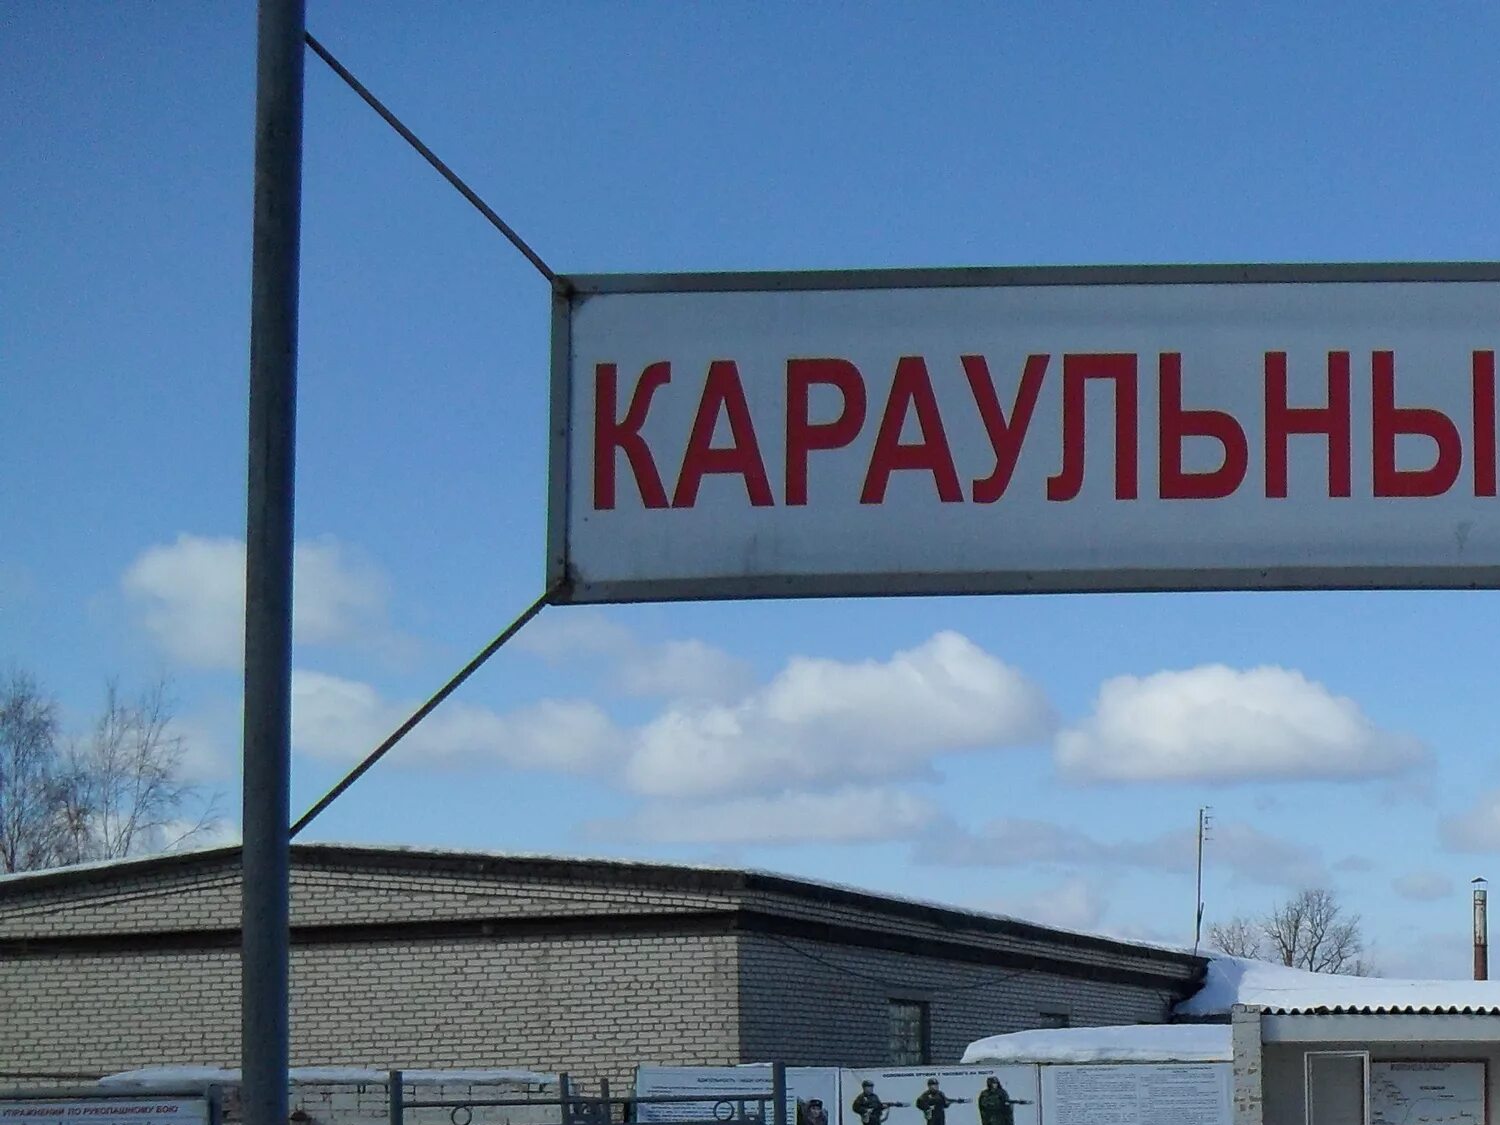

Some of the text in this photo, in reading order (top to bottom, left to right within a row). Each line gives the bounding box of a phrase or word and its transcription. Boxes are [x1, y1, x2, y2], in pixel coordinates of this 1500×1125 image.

[68, 1107, 82, 1116] ПО
[82, 1105, 153, 1115] РУКОПАШНОМУ
[156, 1104, 179, 1113] БОЮ
